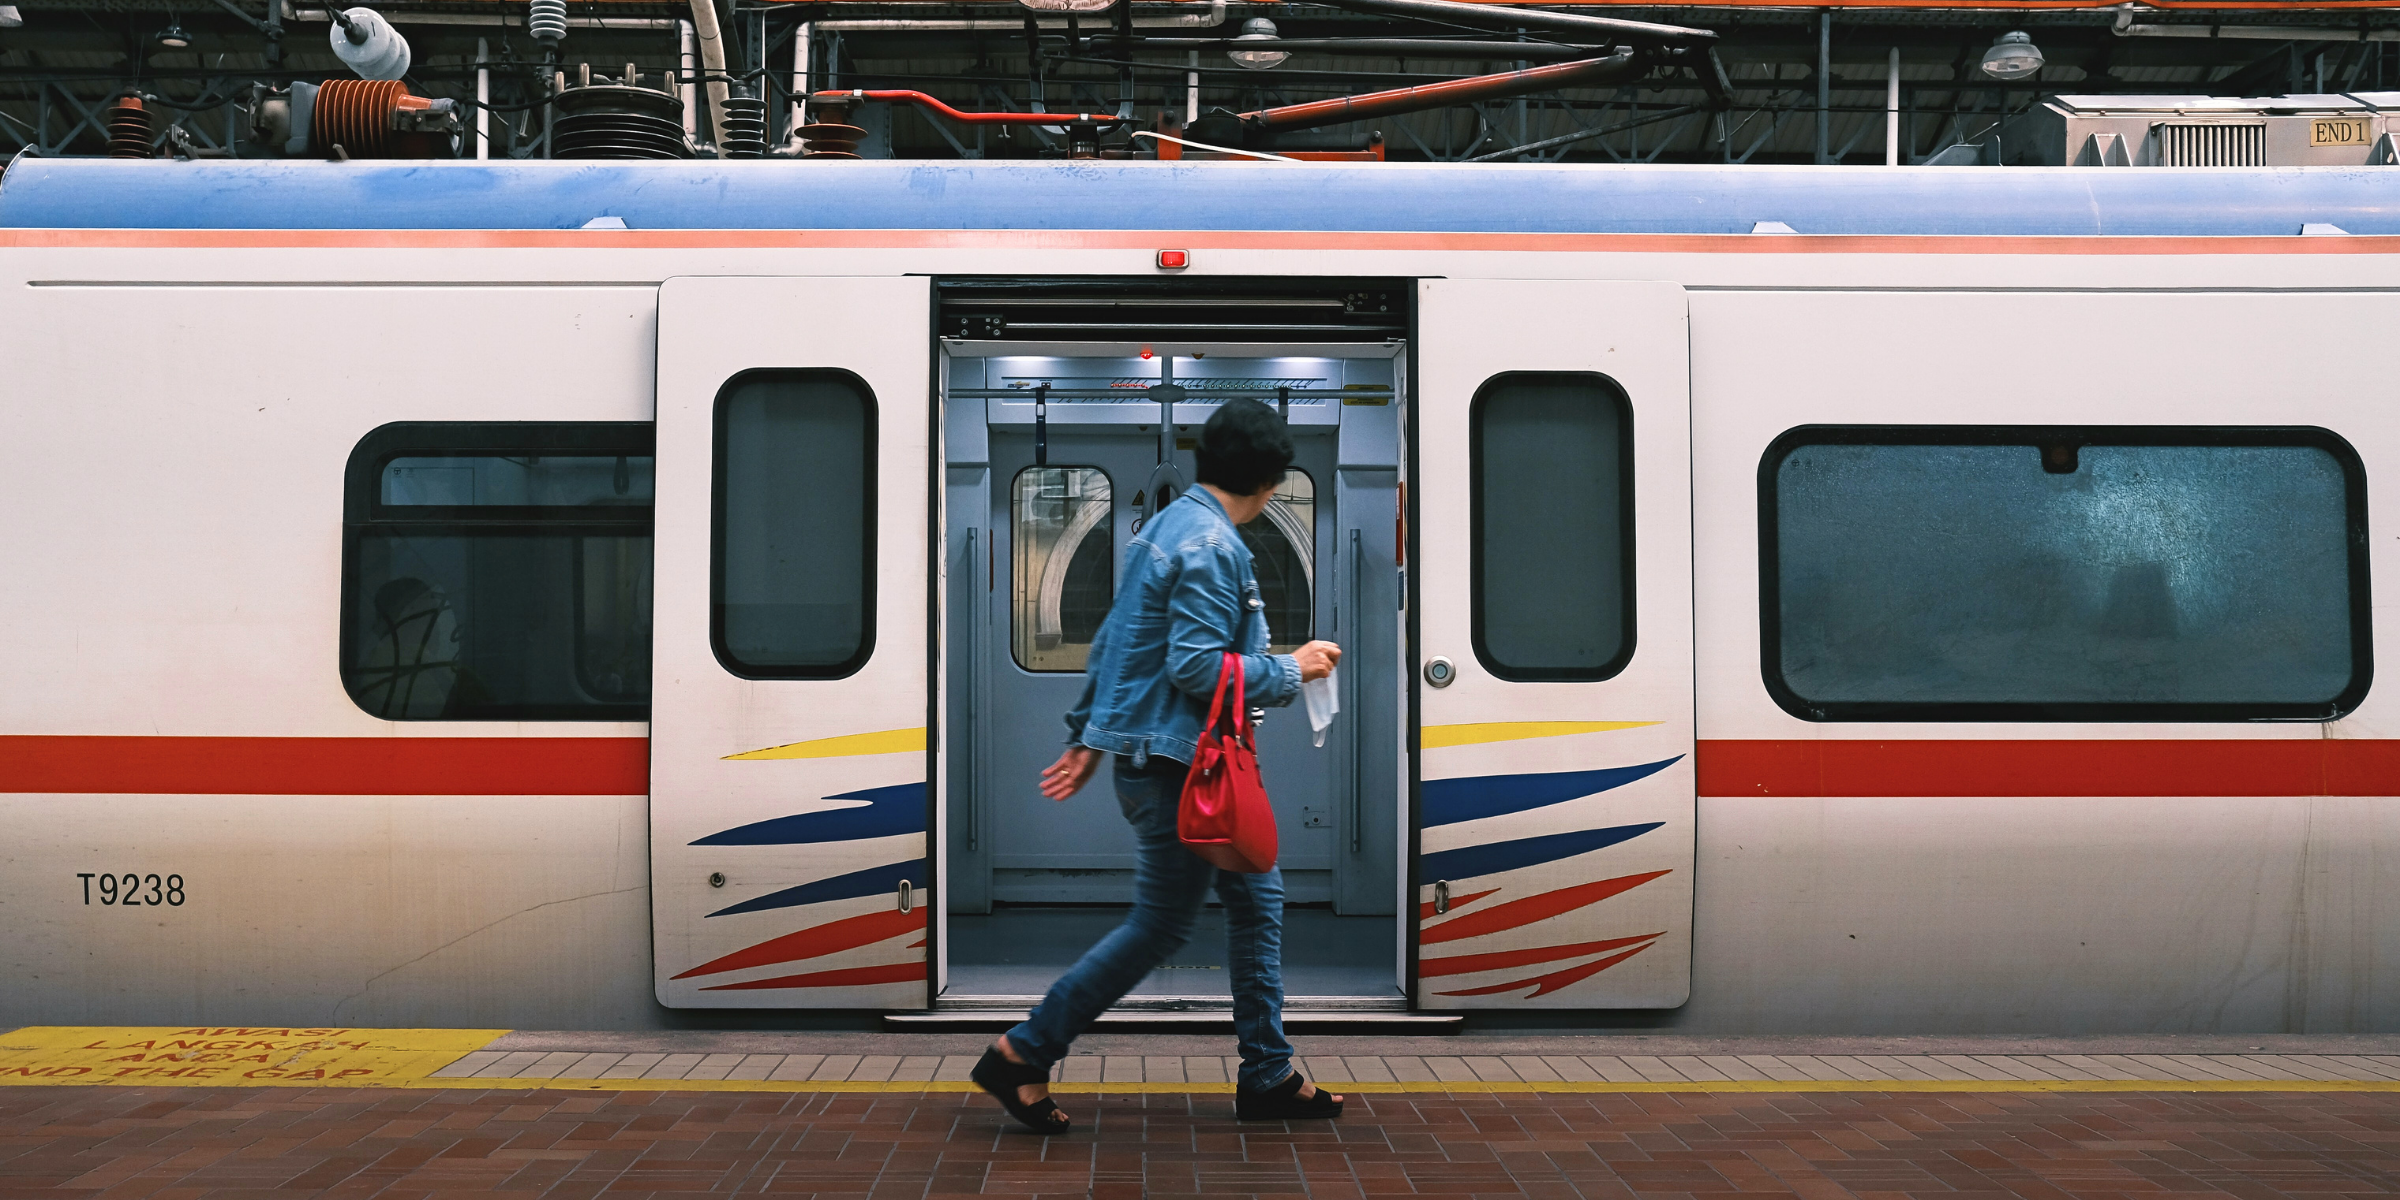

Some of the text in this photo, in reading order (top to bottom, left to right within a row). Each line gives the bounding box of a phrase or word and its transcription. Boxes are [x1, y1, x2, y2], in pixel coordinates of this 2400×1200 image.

[2315, 122, 2365, 143] END 1
[76, 873, 186, 907] T9238
[166, 1028, 351, 1037] AWASI
[102, 1053, 270, 1063] ANDA
[112, 1066, 231, 1078] THE
[242, 1067, 374, 1079] GAP
